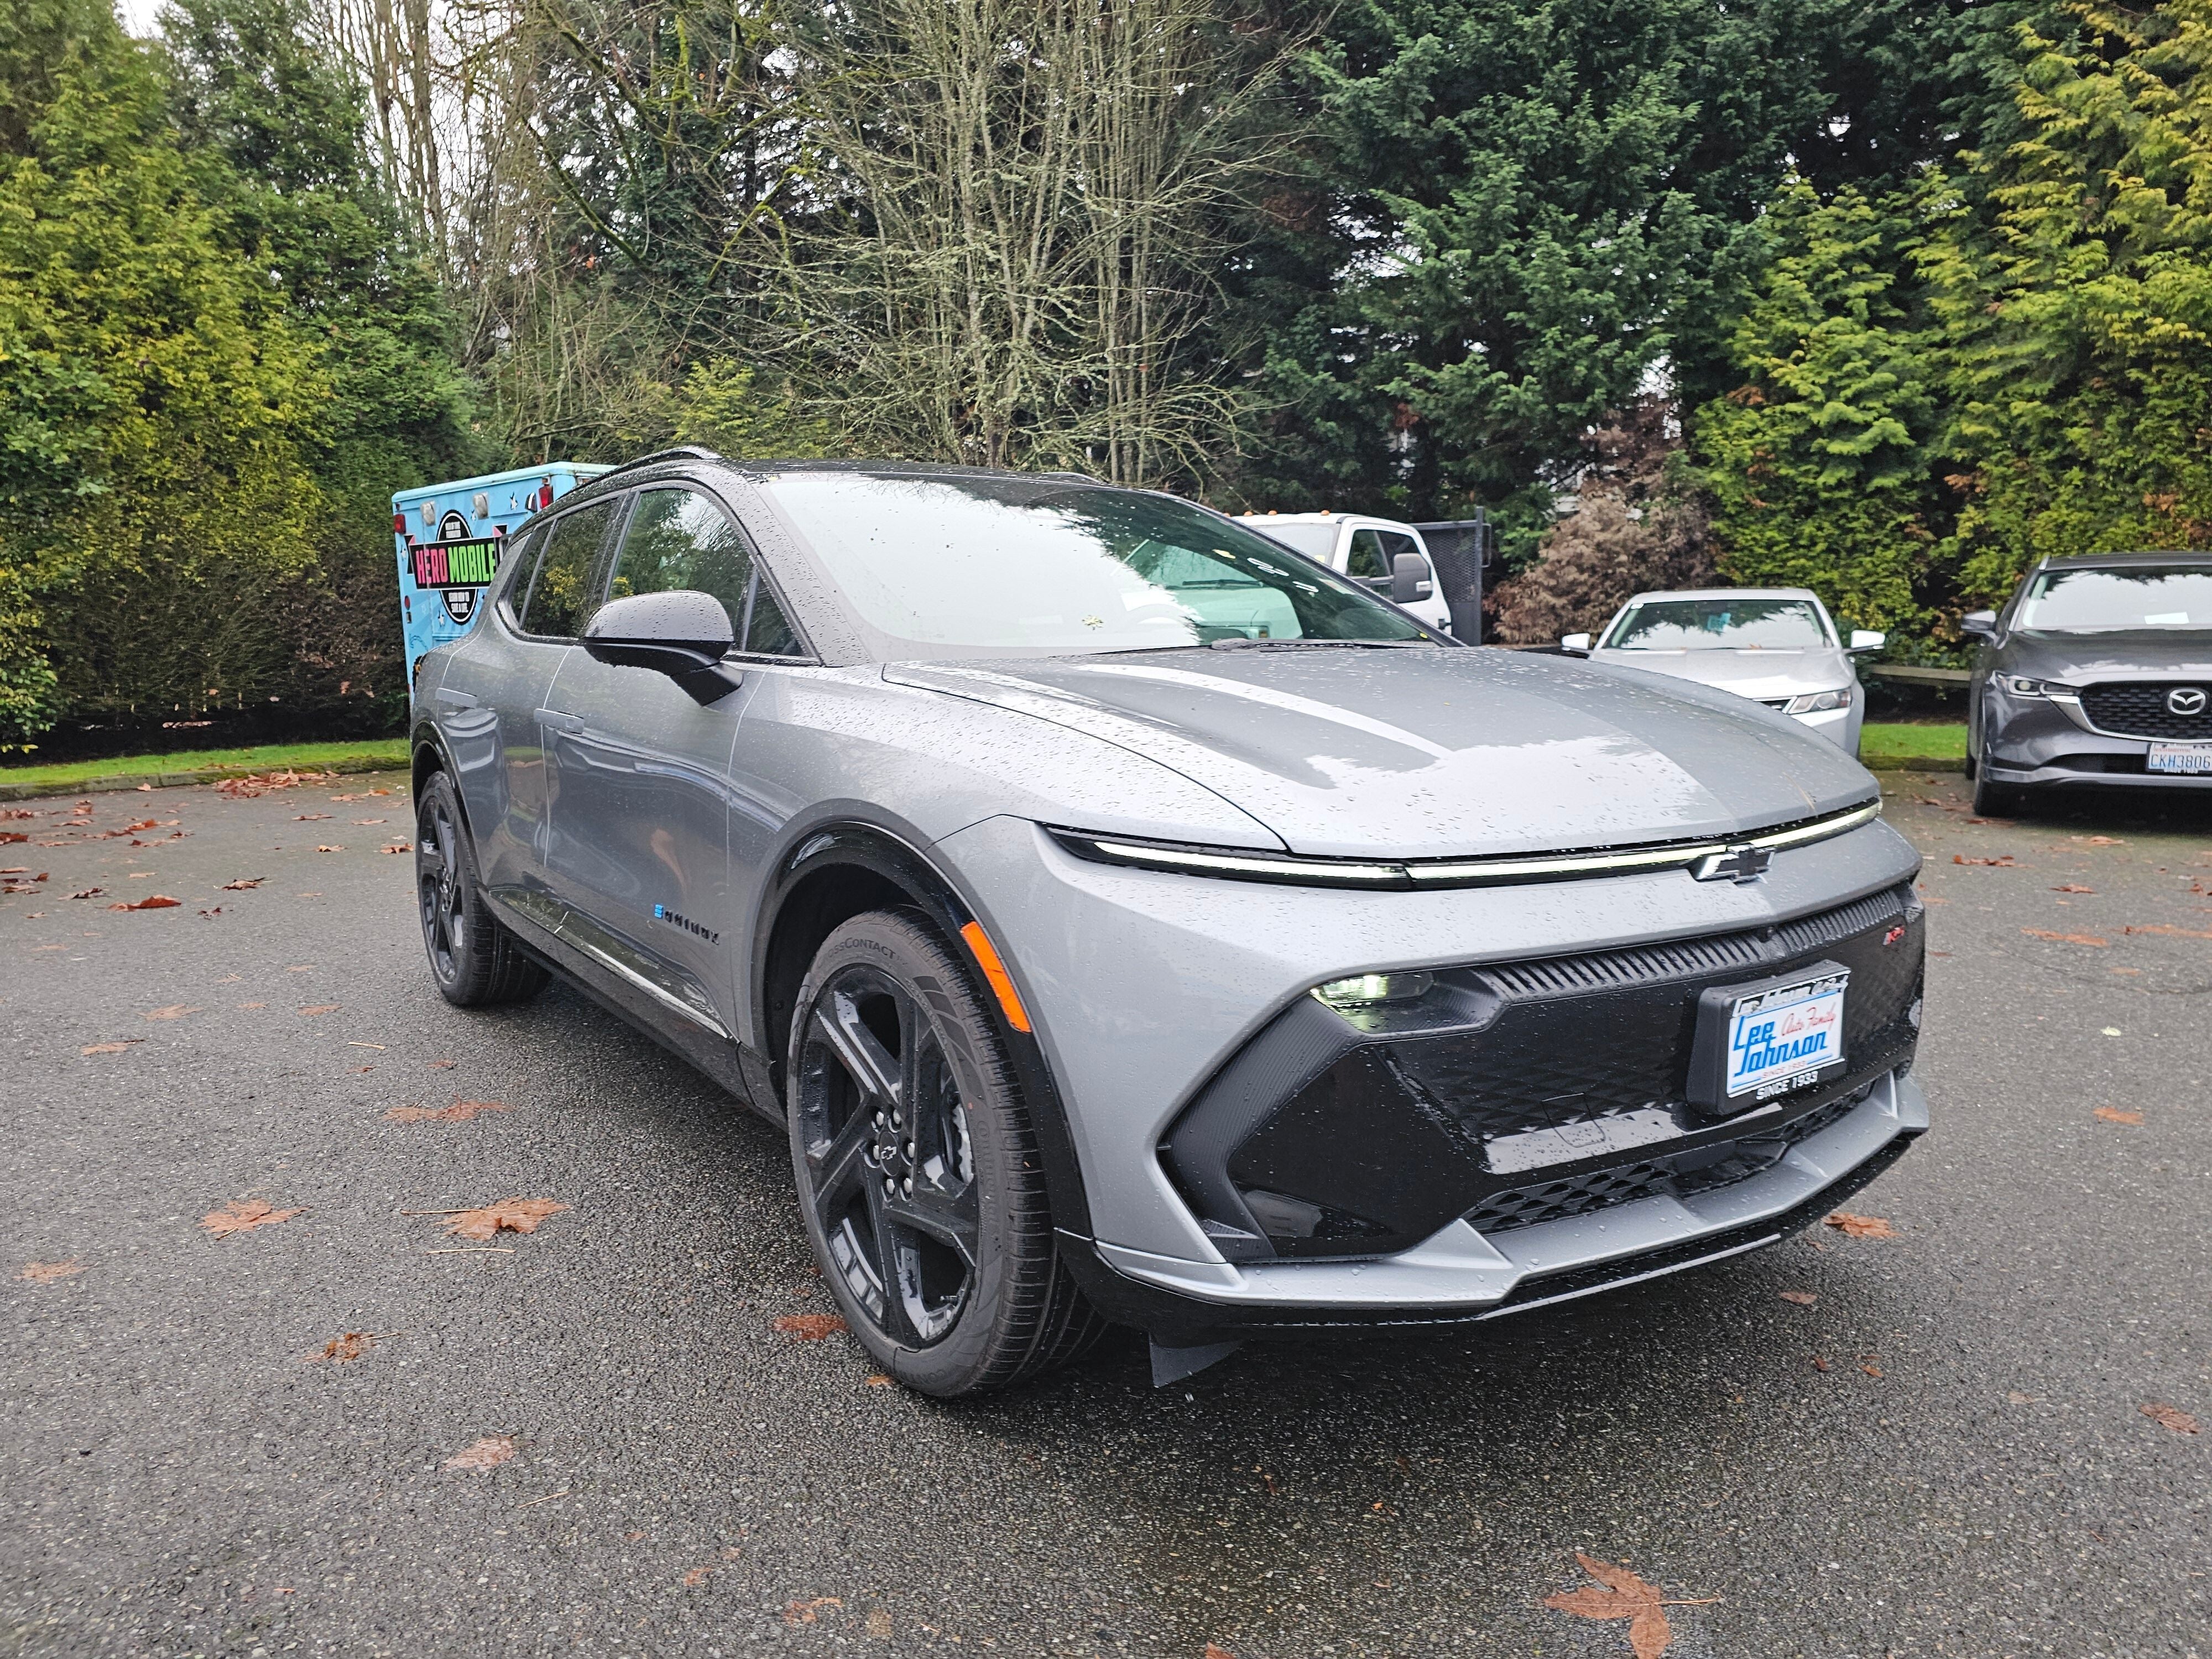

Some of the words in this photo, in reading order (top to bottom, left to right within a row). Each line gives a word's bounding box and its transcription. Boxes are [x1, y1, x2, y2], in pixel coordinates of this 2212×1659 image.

[416, 548, 448, 583] HERO
[447, 543, 496, 583] MOBILE
[2151, 754, 2211, 769] CKH3806
[1733, 1016, 1777, 1051] Lee
[1734, 1031, 1827, 1077] Johnson
[1756, 1079, 1790, 1100] SINCE
[1791, 1070, 1818, 1088] 1933
